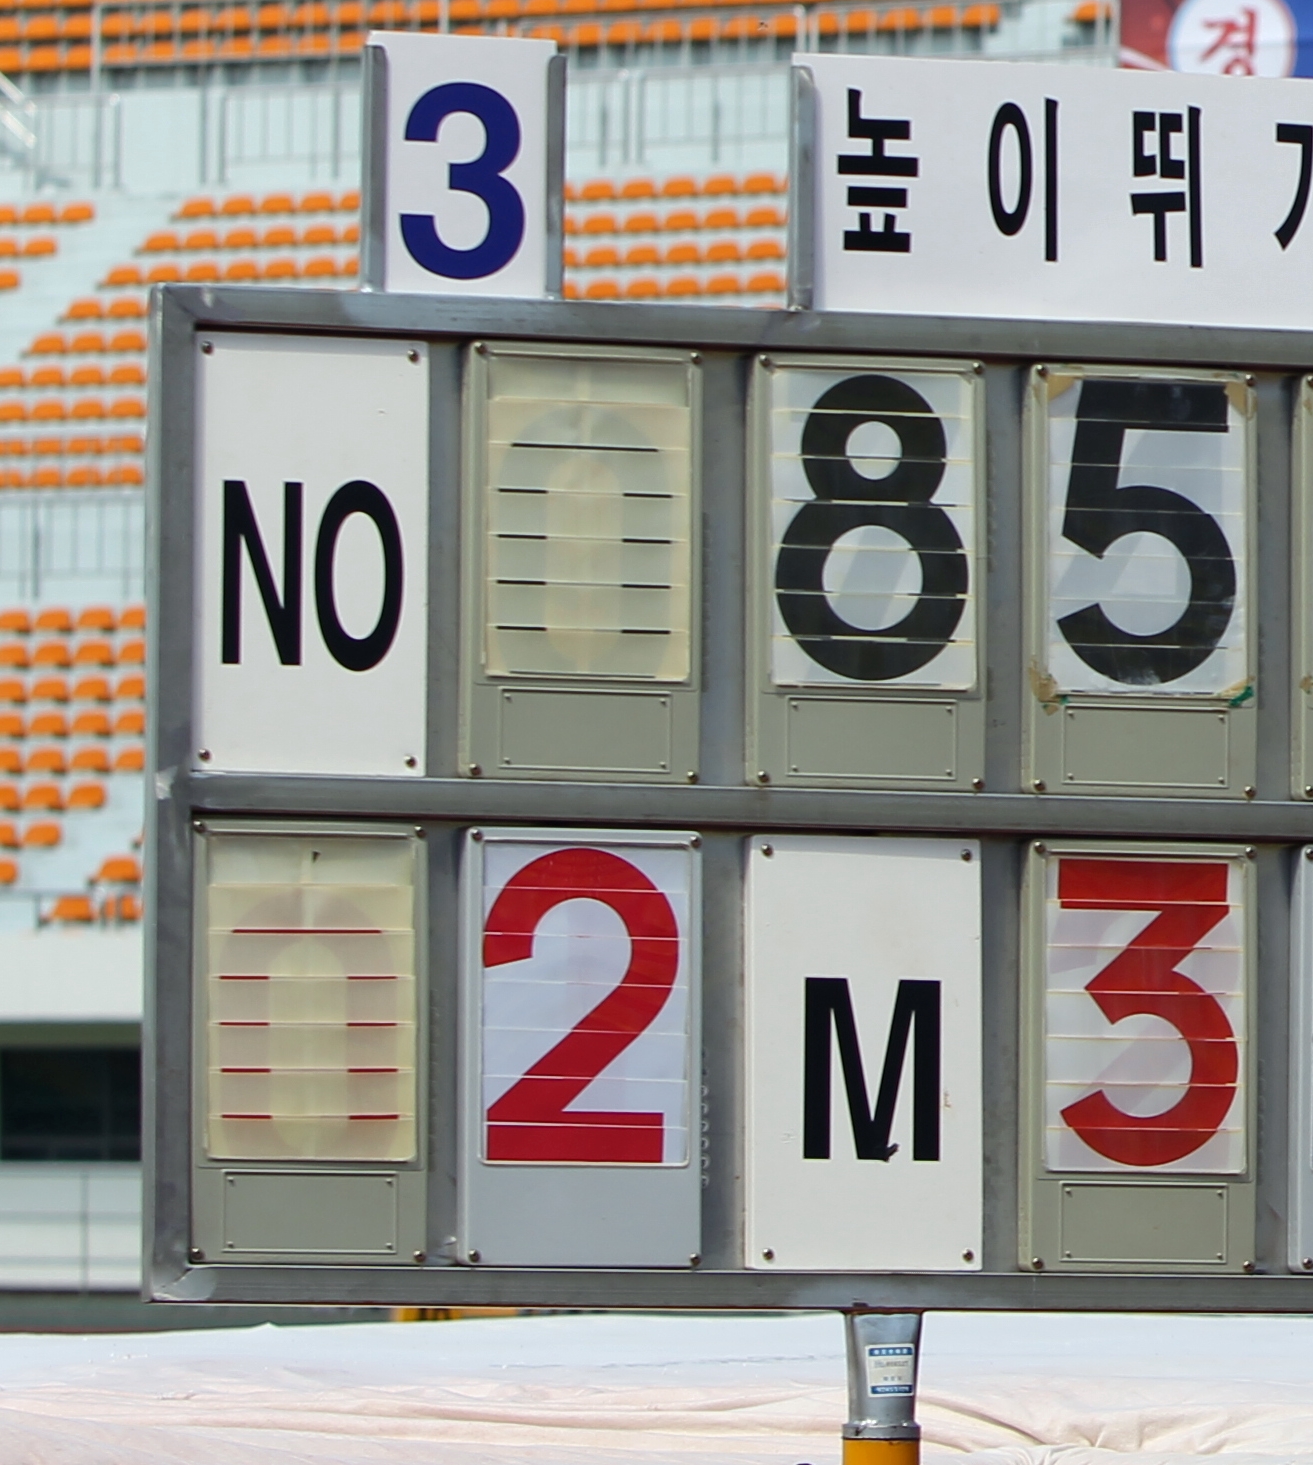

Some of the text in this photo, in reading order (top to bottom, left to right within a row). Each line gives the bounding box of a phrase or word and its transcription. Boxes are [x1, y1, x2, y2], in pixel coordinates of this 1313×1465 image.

[399, 81, 525, 279] 3
[220, 479, 404, 672] NO
[484, 847, 679, 1163] 2
[802, 977, 942, 1162] M
